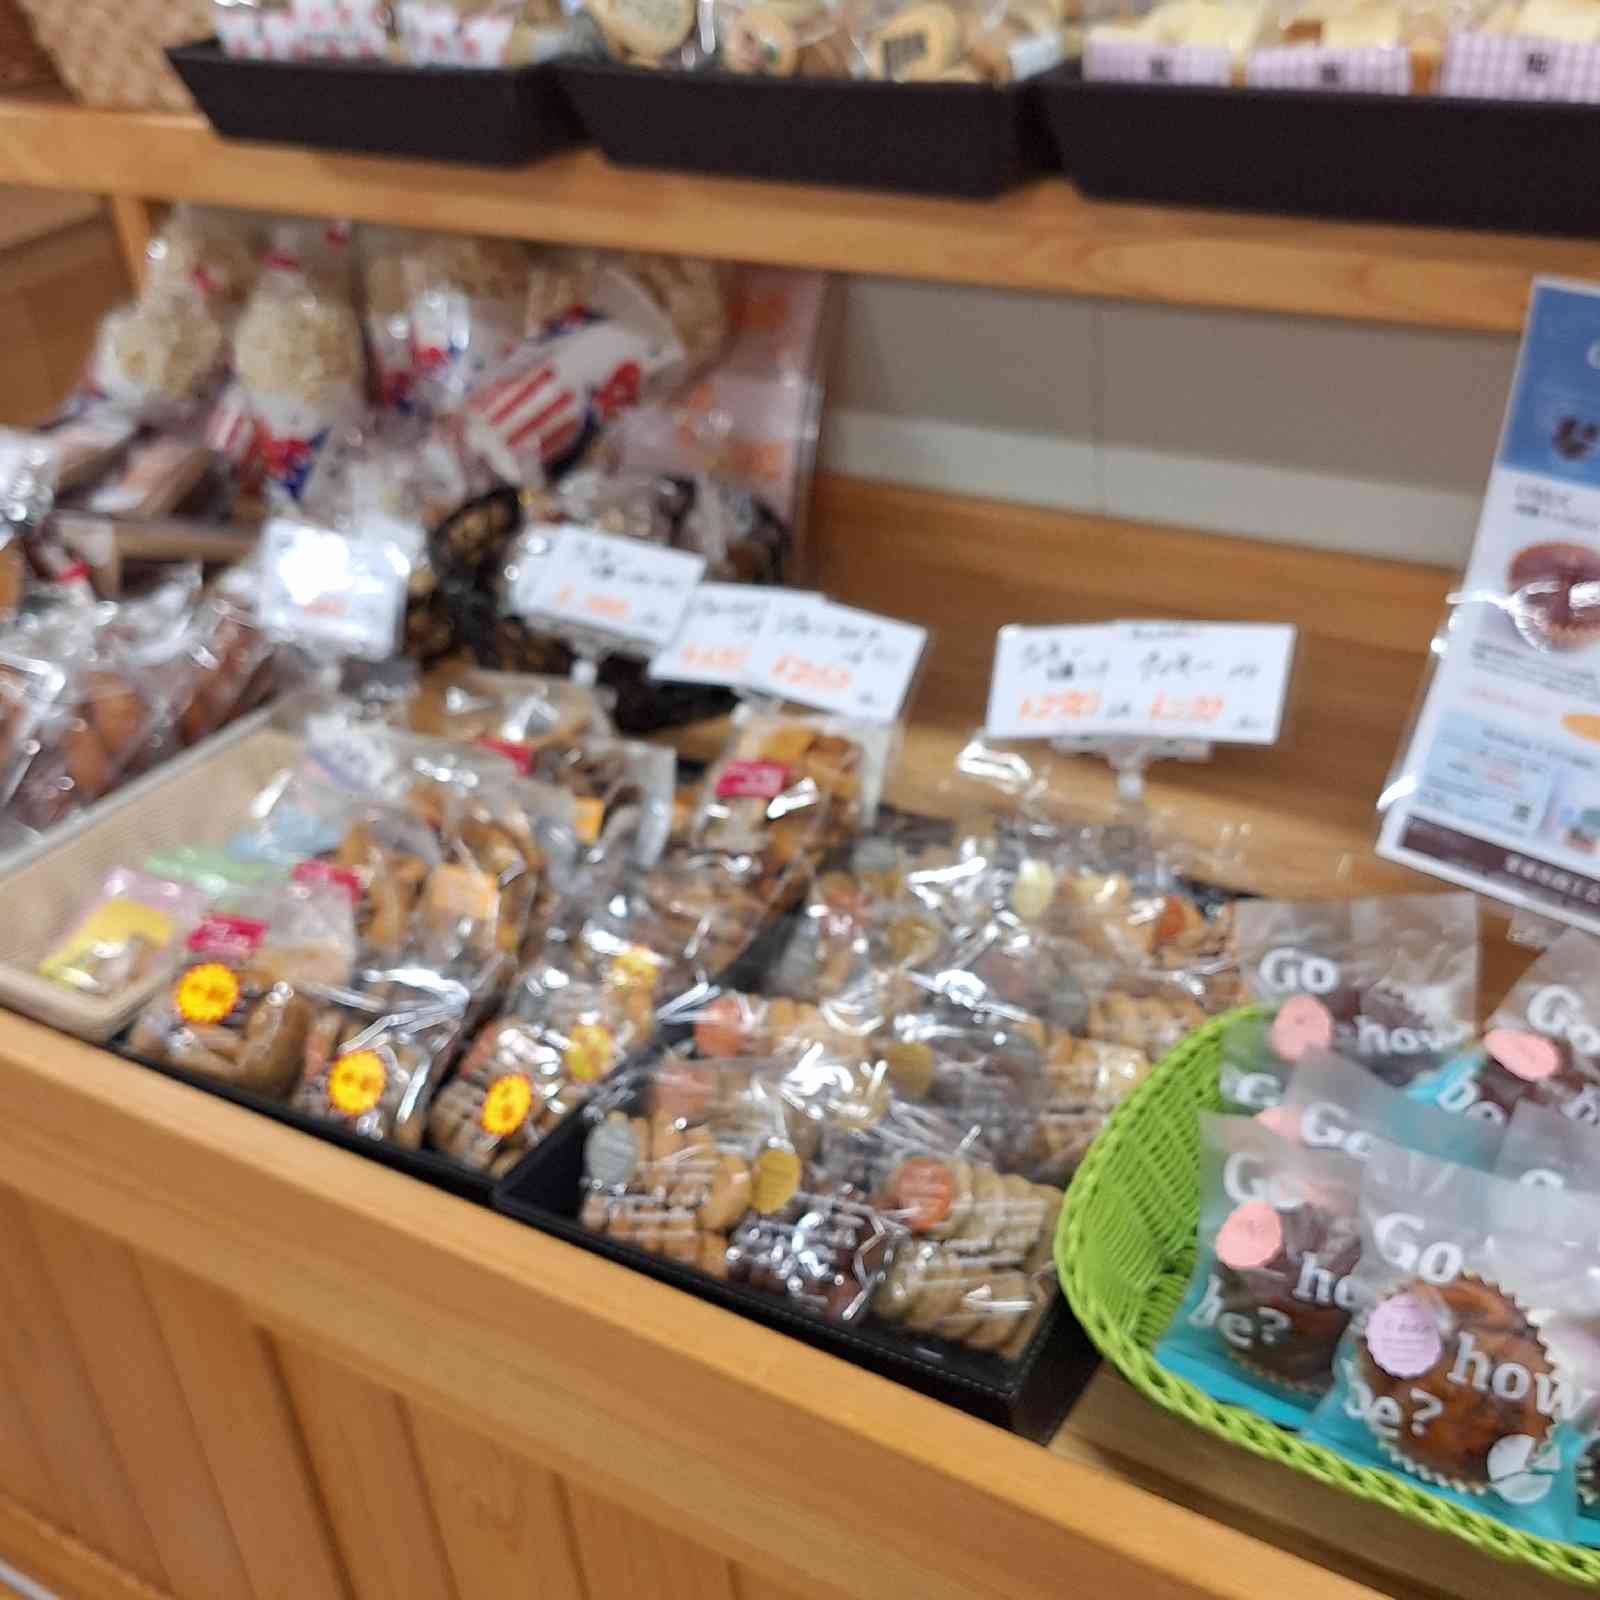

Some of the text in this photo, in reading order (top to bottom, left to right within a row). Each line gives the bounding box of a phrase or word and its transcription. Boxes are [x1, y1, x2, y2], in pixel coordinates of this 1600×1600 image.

[1258, 946, 1341, 994] Go
[1526, 984, 1600, 1059] Go
[1292, 1251, 1360, 1314] ho
[1374, 1211, 1463, 1284] Go
[1187, 1273, 1292, 1349] be?
[1342, 1357, 1444, 1439] be?
[1446, 1331, 1596, 1427] how
